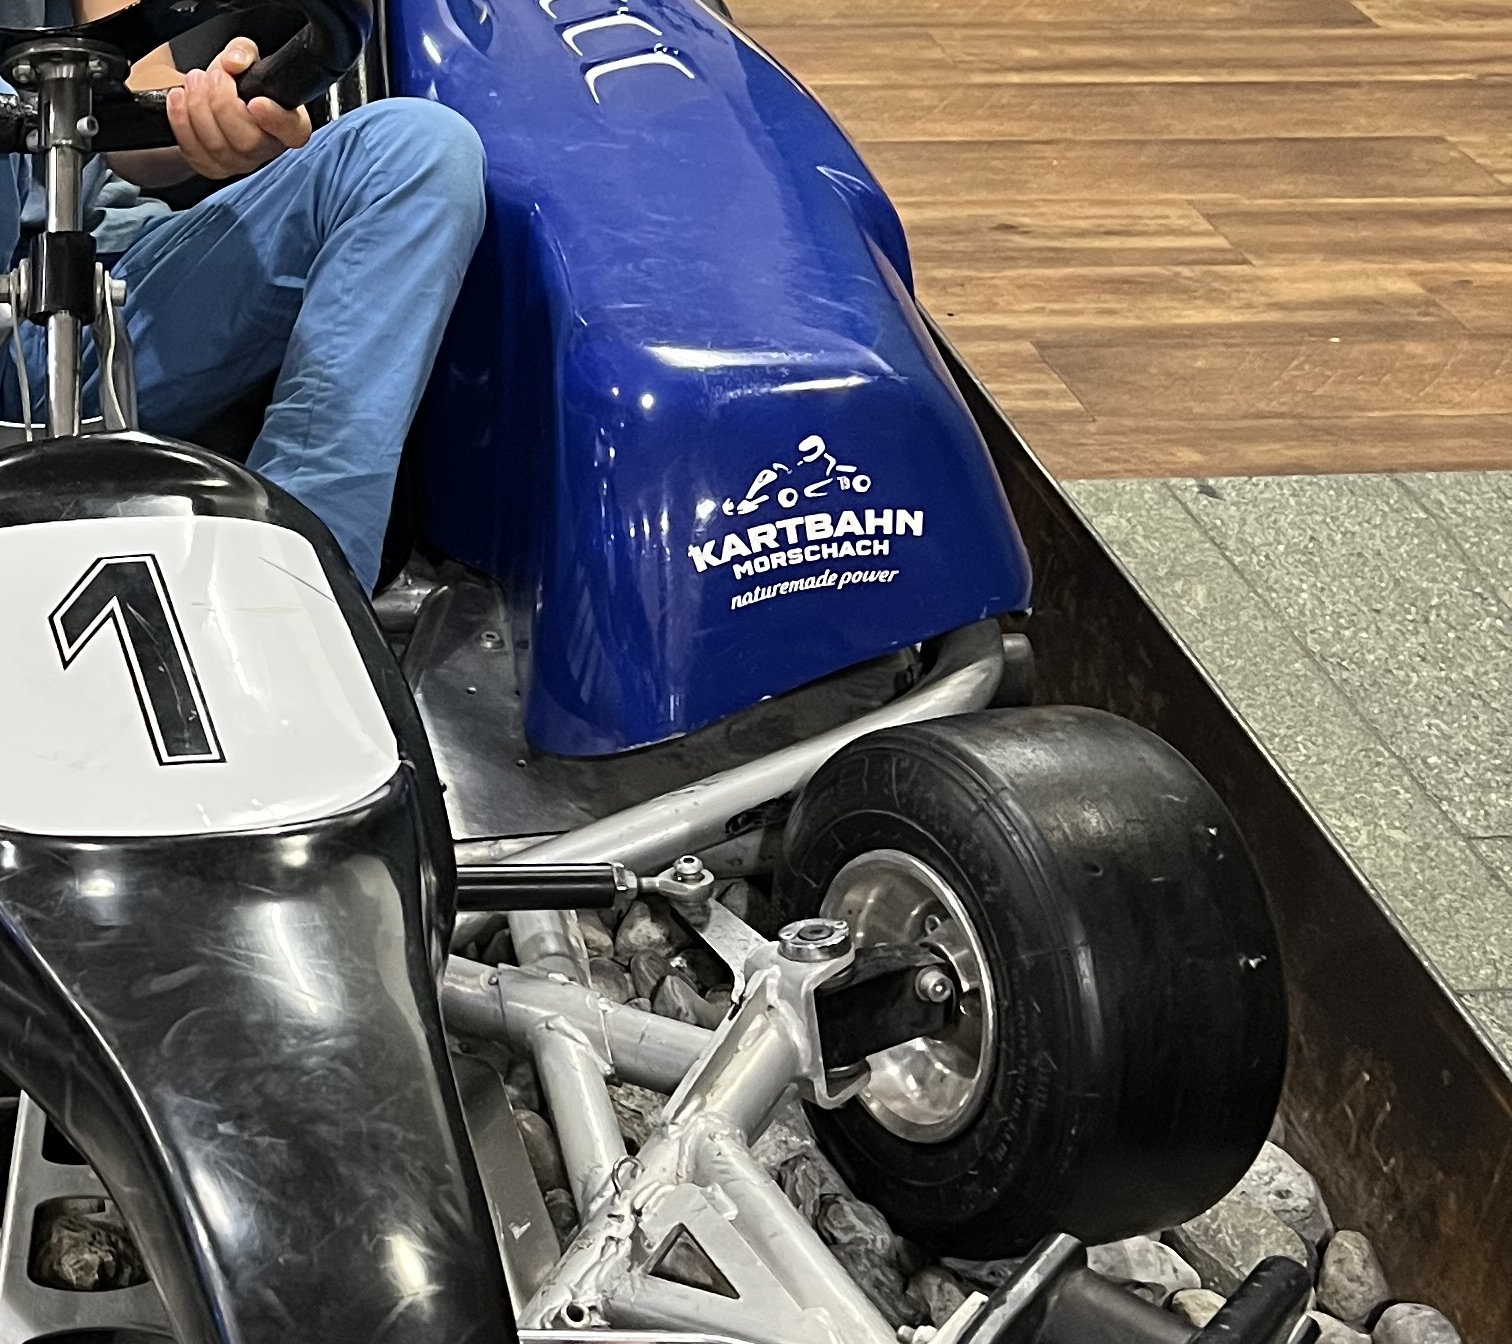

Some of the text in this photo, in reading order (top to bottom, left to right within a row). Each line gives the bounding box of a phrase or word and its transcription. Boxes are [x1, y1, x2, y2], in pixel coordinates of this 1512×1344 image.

[689, 508, 925, 573] KARTBAHN
[732, 538, 890, 580] MORSCHACH
[730, 568, 900, 610] naturemade power
[48, 553, 227, 766] 1
